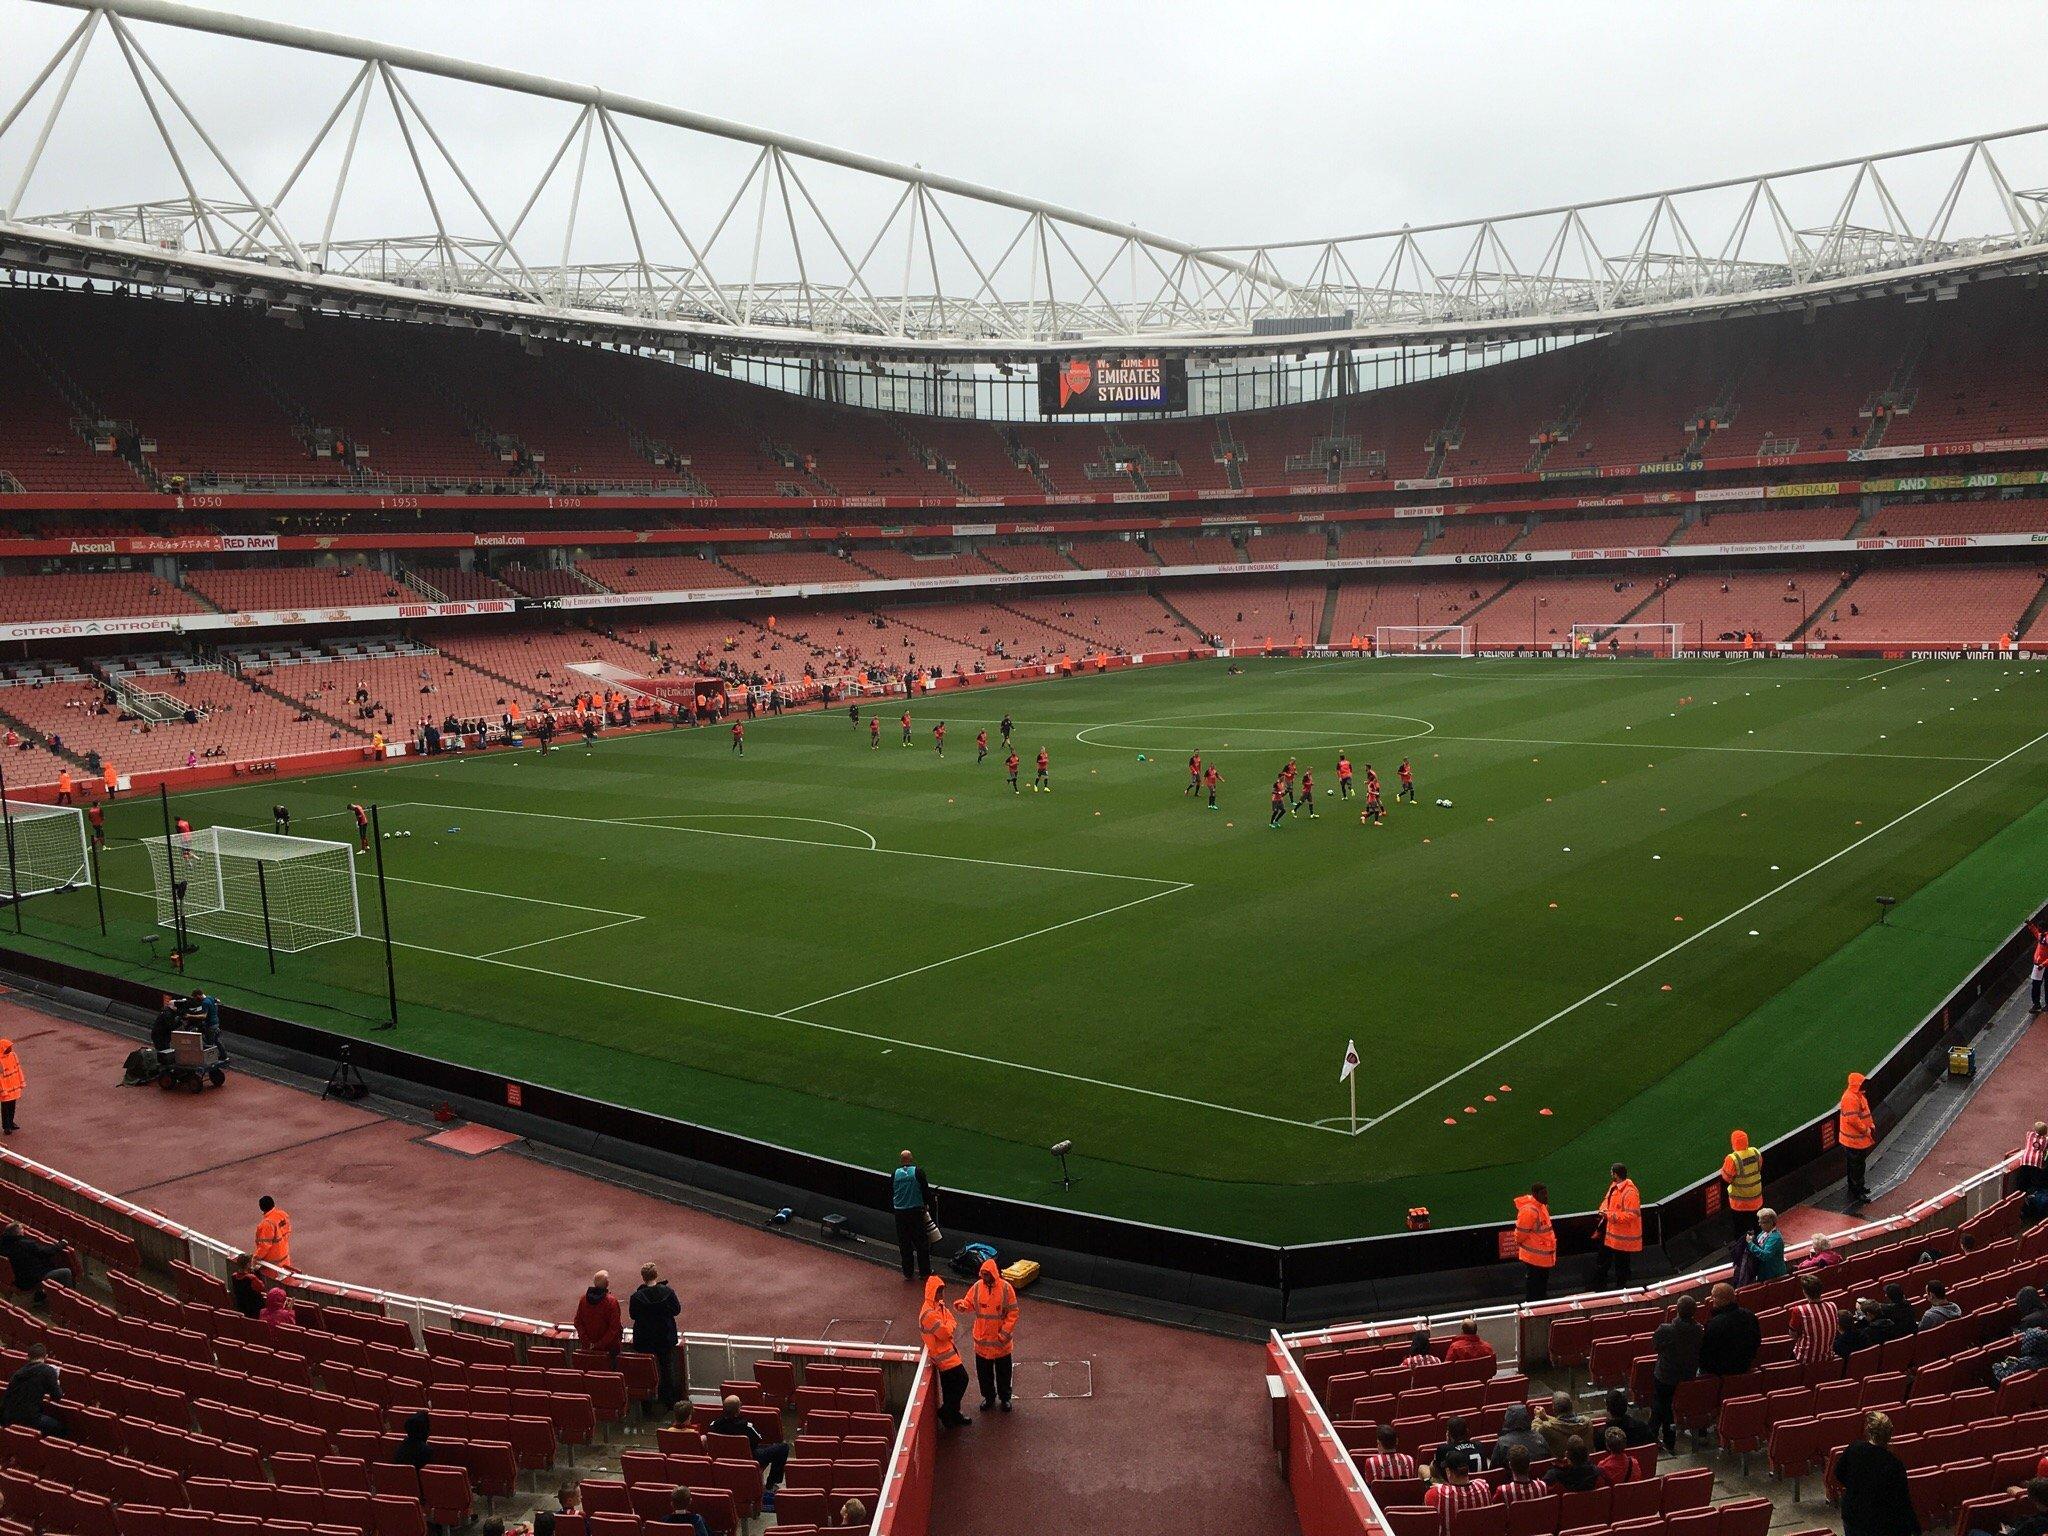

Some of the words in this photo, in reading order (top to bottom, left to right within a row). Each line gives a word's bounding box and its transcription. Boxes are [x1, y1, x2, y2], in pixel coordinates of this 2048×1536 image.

[1097, 360, 1143, 368] WOME
[1146, 359, 1160, 368] TO
[1097, 368, 1160, 384] EMIRATES
[1098, 386, 1161, 401] STADIUM
[1945, 444, 1971, 454] 1993
[1767, 457, 1791, 466] 1991
[1609, 467, 1631, 477] 1989
[1640, 463, 1684, 474] ANFIELD
[1467, 477, 1487, 486] 1987
[1899, 478, 1926, 490] AND
[1968, 474, 1998, 487] AND
[1778, 484, 1837, 496] AUSTRALIA
[192, 497, 222, 507] 1950
[392, 497, 418, 507] 1953
[558, 498, 581, 508] 1970
[1577, 498, 1624, 508] Arsenal.com
[1298, 513, 1325, 522] Arsenal
[1015, 524, 1054, 533] Arsenal.com
[474, 534, 525, 546] Arsenal.com
[768, 530, 791, 540] Arsenal
[70, 540, 115, 553] Arsenal
[224, 538, 245, 549] RED
[247, 537, 275, 549] ARMY
[1857, 540, 1884, 549] PUMA
[1896, 538, 1925, 548] PUMA
[1938, 537, 1966, 547] PUMA
[1469, 553, 1517, 563] GATORADE
[1571, 550, 1594, 559] PUMA
[1604, 549, 1627, 558] PUMA
[1638, 548, 1661, 557] PUMA
[400, 606, 427, 617] PUMA
[440, 604, 466, 615] PUMA
[478, 602, 504, 613] PUMA
[11, 624, 82, 637] CITROËN
[104, 619, 170, 632] CITROËN
[1752, 651, 1764, 659] ON
[1912, 651, 1961, 660] EXCLUSIVE
[1966, 651, 1994, 660] VIDEO
[1999, 651, 2013, 660] ON
[656, 687, 667, 698] Fly
